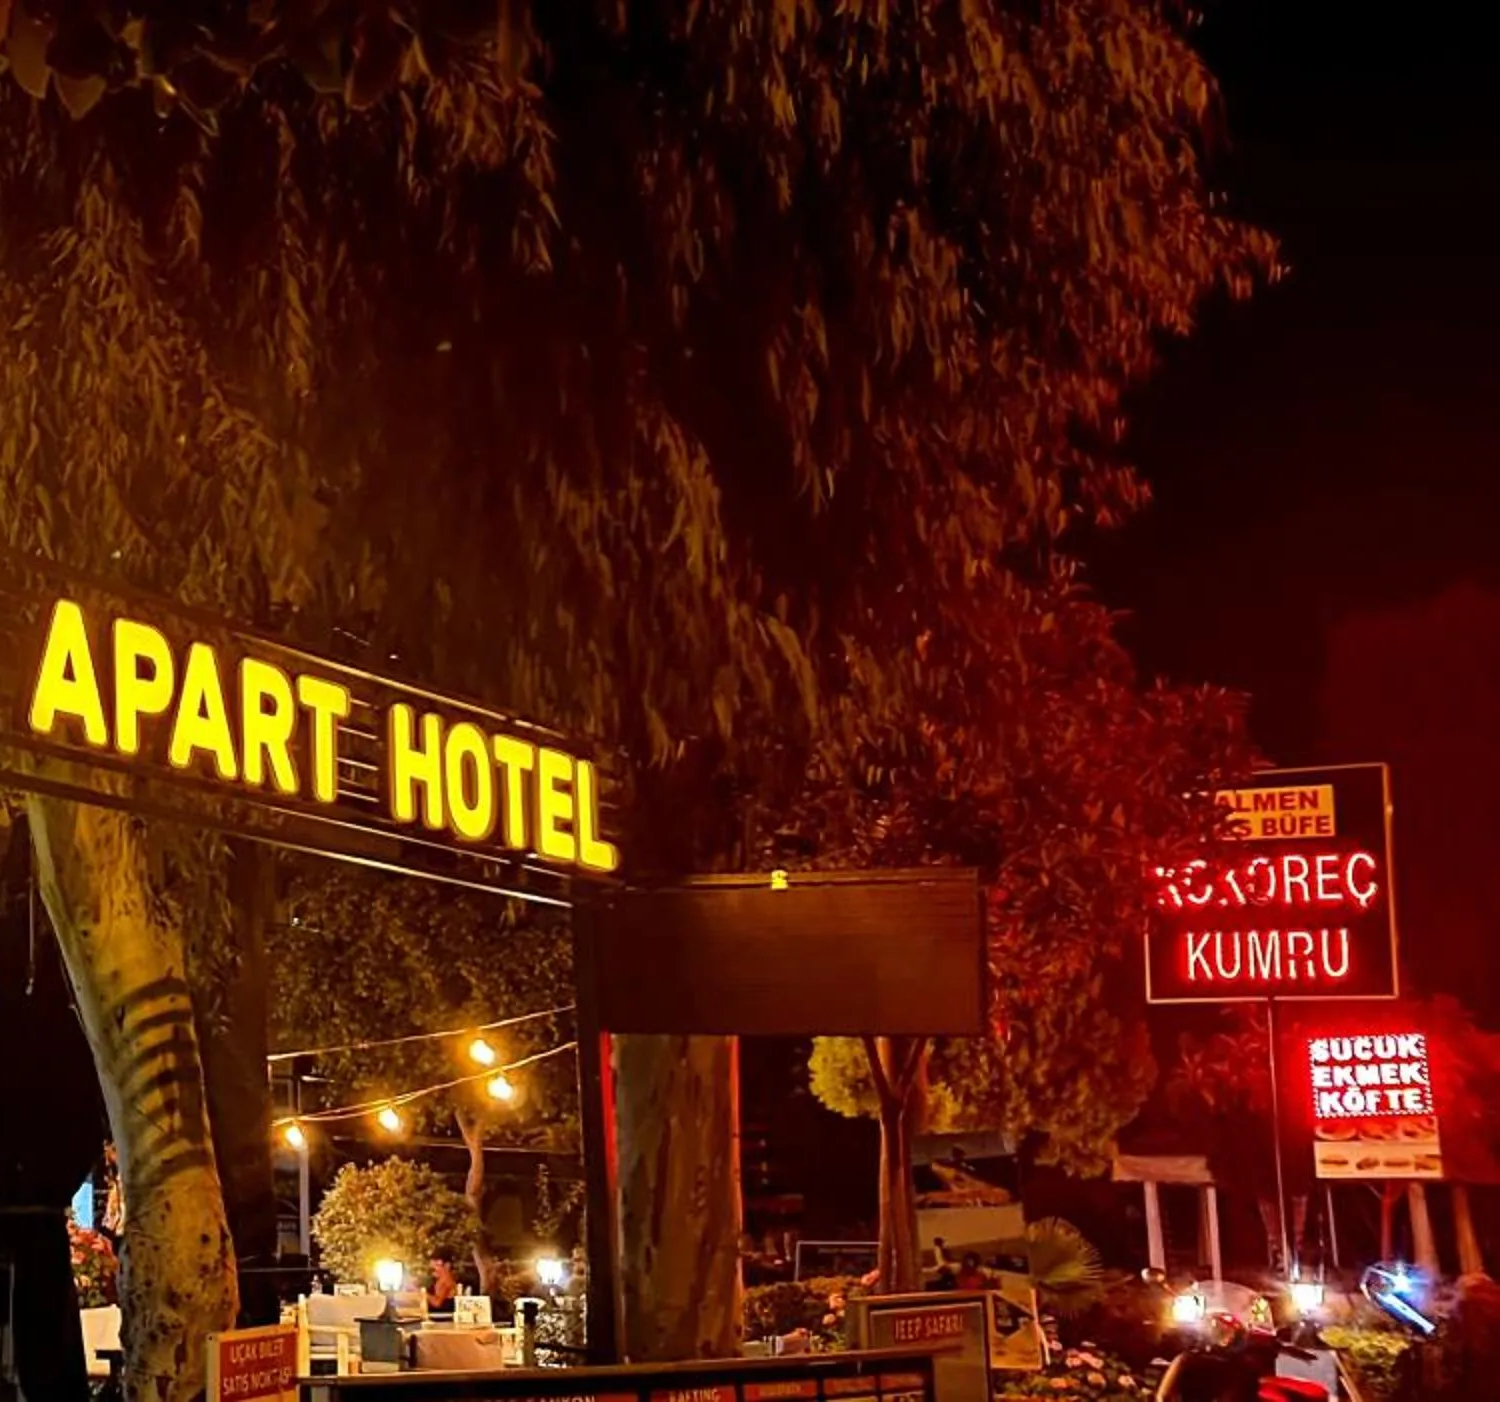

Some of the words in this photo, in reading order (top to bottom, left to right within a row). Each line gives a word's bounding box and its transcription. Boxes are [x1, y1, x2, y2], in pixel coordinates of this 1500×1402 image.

[29, 599, 350, 804] APART
[389, 702, 618, 872] HOTEL
[1214, 791, 1319, 813] ALMEN
[1262, 813, 1332, 836] BÜFE
[1185, 927, 1350, 981] KUMRU
[1310, 1035, 1424, 1063] SUCUK
[1312, 1062, 1428, 1087] EKMEK
[1318, 1087, 1425, 1114] KÖFTE
[894, 1316, 920, 1342] JEEP
[924, 1313, 964, 1338] SAFARI
